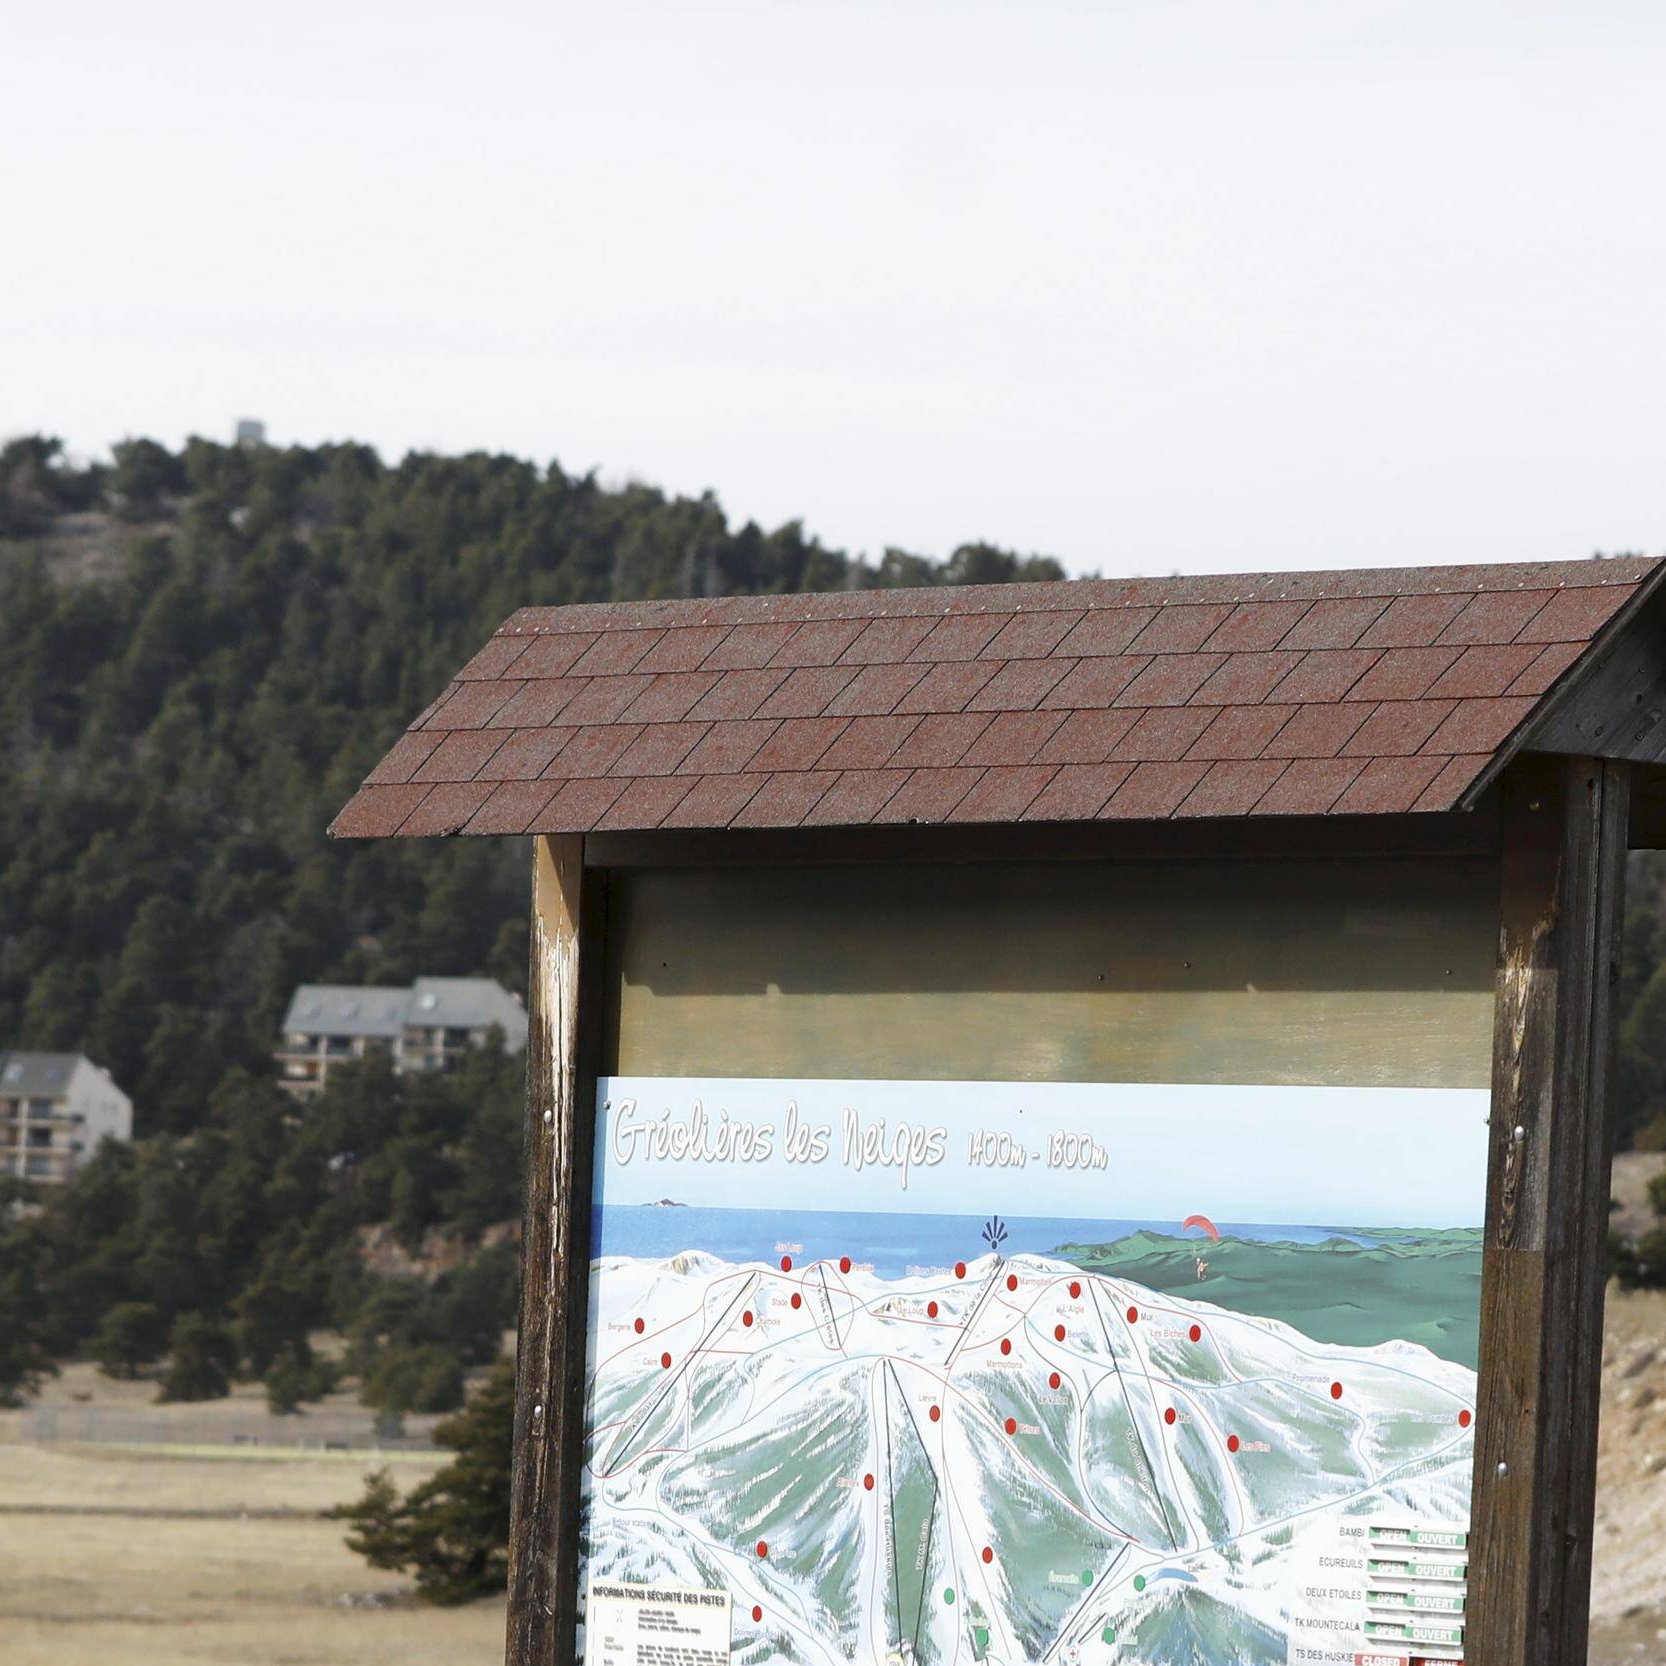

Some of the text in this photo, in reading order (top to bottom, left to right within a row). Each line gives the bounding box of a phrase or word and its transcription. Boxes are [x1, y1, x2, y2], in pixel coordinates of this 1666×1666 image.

[609, 1097, 774, 1164] Gréolières
[784, 1099, 831, 1163] les
[842, 1107, 947, 1189] Neiges
[967, 1128, 1026, 1168] 1400m
[1046, 1128, 1108, 1170] 1800m
[1340, 1526, 1365, 1537] BAMBI
[1379, 1529, 1458, 1545] OPEN OUVERT
[1319, 1557, 1364, 1569] ECUREUILS
[1377, 1561, 1457, 1577] OPEN OUVERT
[593, 1586, 645, 1601] INFORMATIONS
[684, 1593, 698, 1604] DES
[699, 1594, 725, 1607] PISTES
[1306, 1587, 1362, 1600] DEUX ETOILES
[1376, 1593, 1456, 1609] OPEN OUVERT
[1295, 1617, 1305, 1628] TK
[1374, 1624, 1454, 1641] OPEN OUVERT
[1296, 1649, 1354, 1662] TS DES HUSKIE
